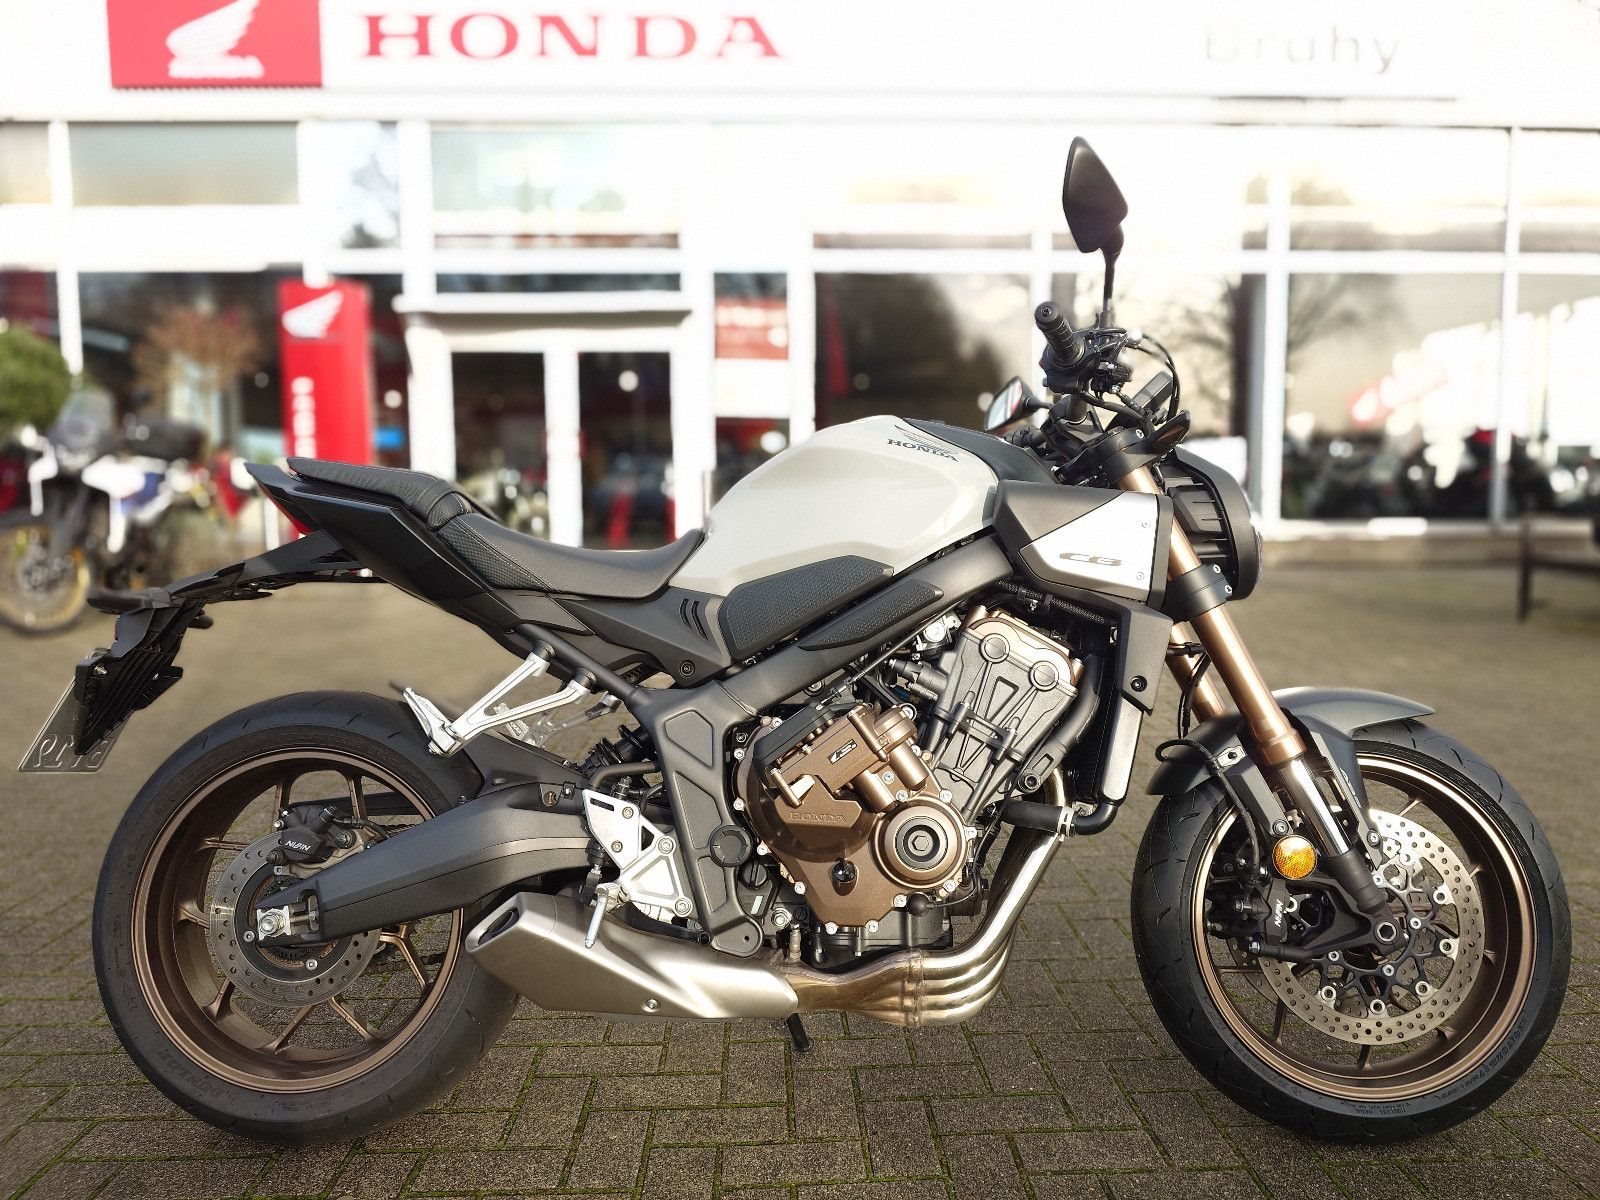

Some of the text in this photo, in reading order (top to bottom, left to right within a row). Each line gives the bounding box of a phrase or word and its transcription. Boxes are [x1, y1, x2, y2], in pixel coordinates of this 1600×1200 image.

[363, 13, 782, 59] HONDA
[887, 438, 959, 463] HONDA
[1059, 552, 1122, 567] CB
